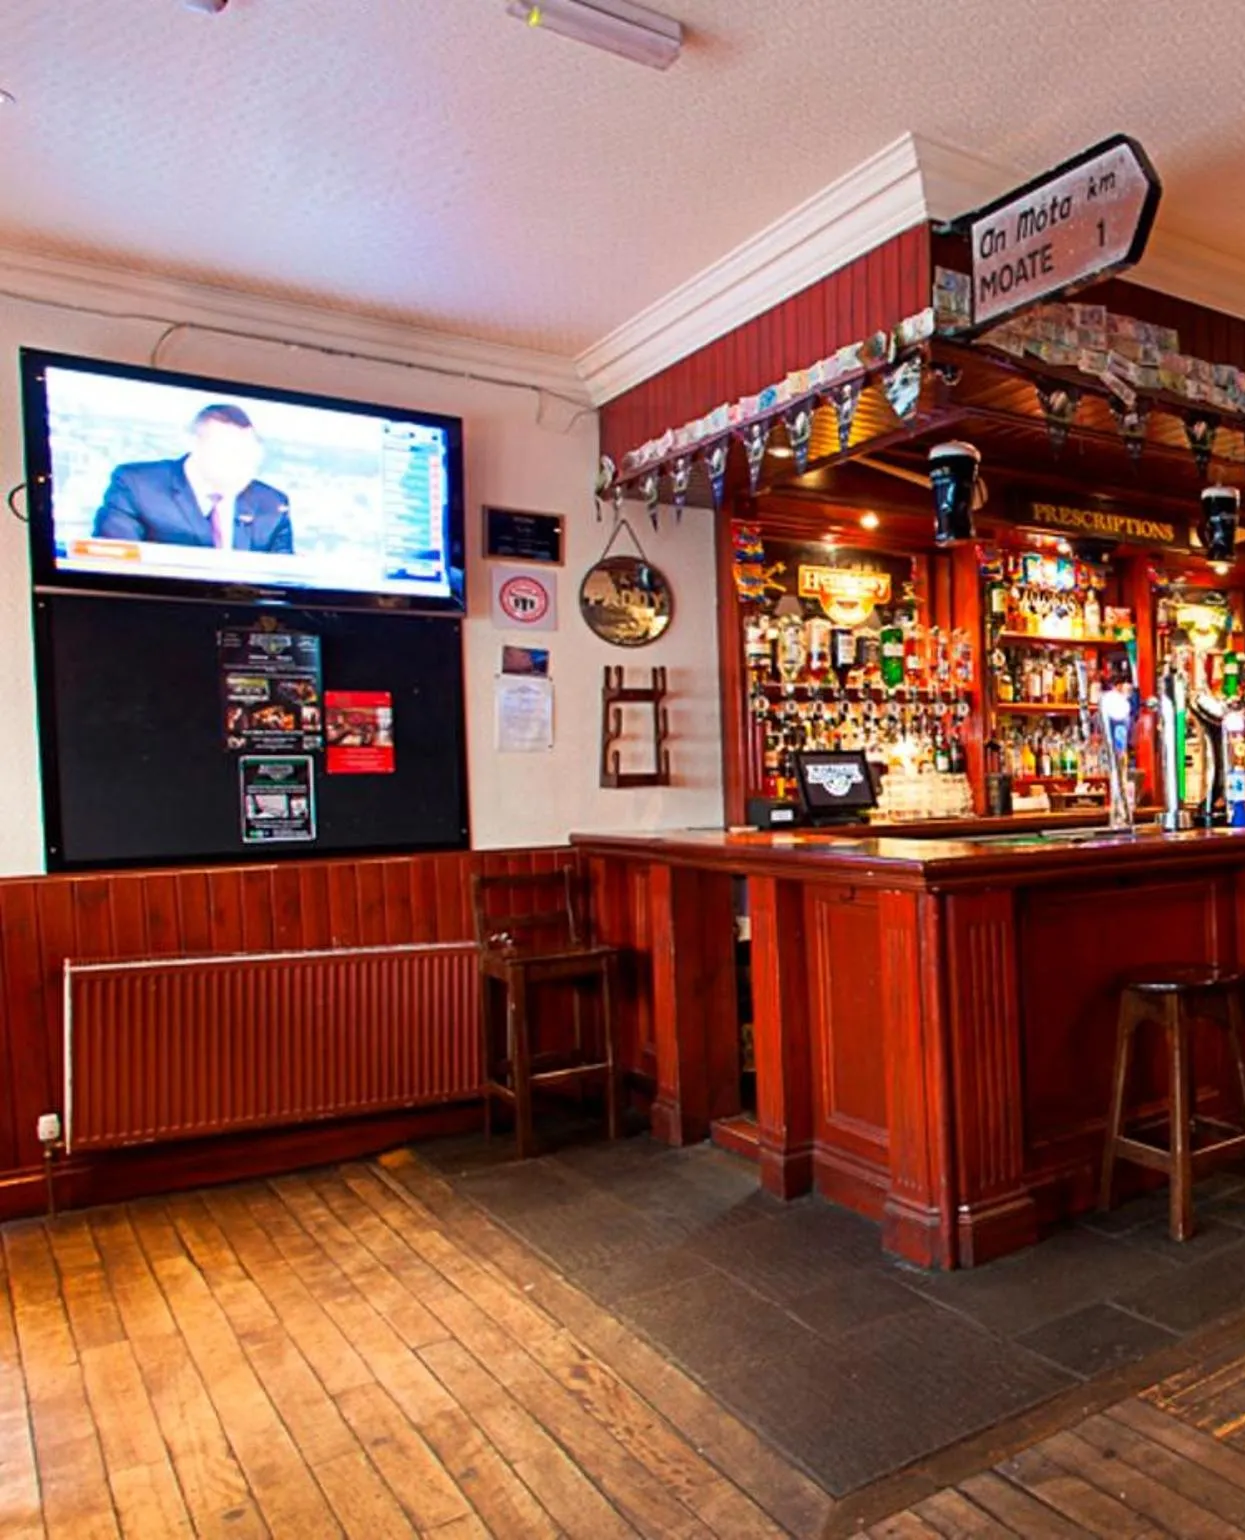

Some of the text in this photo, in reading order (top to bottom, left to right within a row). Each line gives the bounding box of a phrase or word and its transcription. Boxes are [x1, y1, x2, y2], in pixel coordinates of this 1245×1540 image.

[1087, 172, 1116, 201] km
[979, 217, 1105, 301] MOATE 1
[1033, 503, 1175, 542] PRESCRIPTIONS
